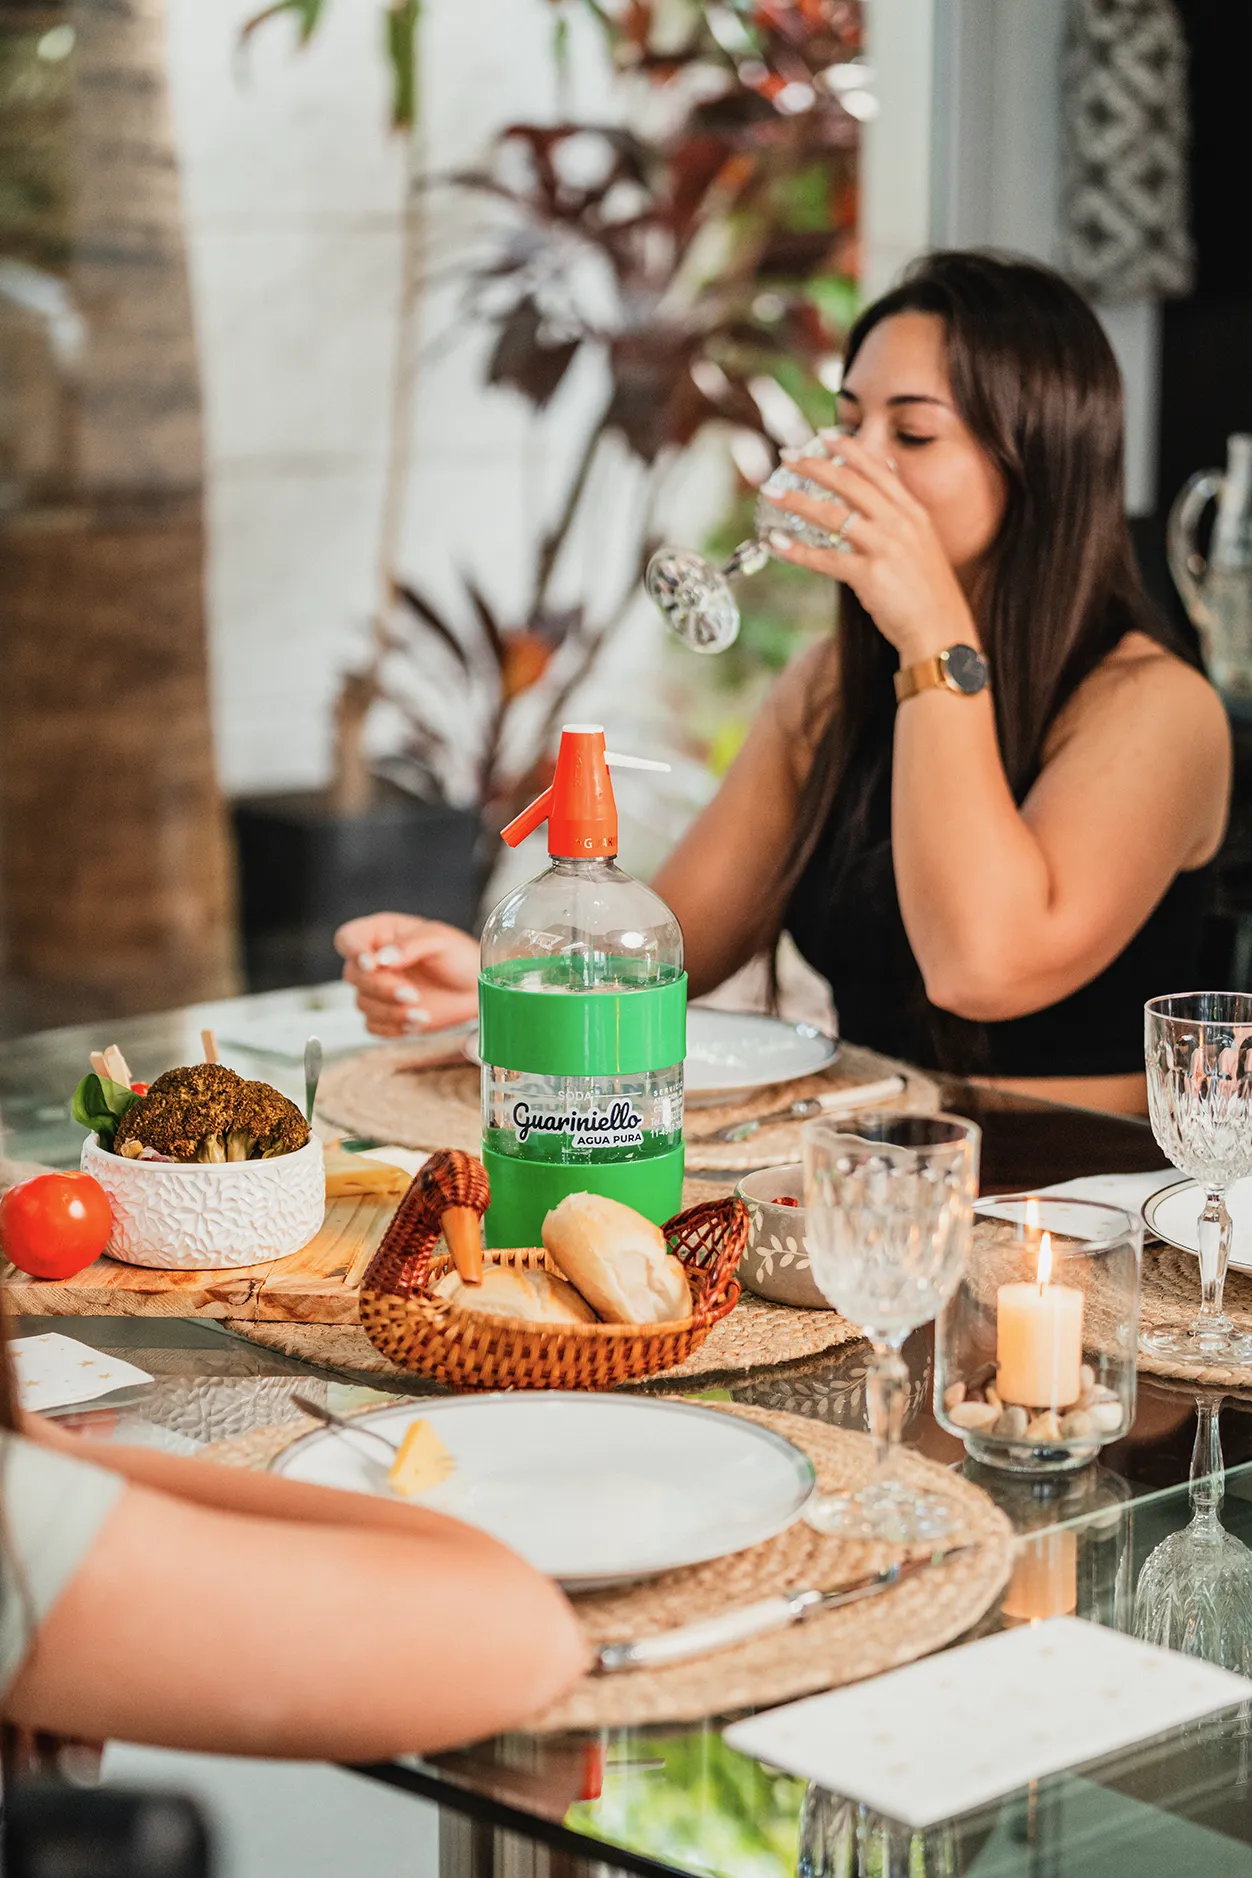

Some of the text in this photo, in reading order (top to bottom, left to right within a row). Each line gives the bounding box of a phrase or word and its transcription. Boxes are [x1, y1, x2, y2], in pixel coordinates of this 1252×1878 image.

[558, 1090, 592, 1101] SODA
[513, 1102, 642, 1141] Guariniello
[577, 1134, 642, 1145] AGUA PURA
